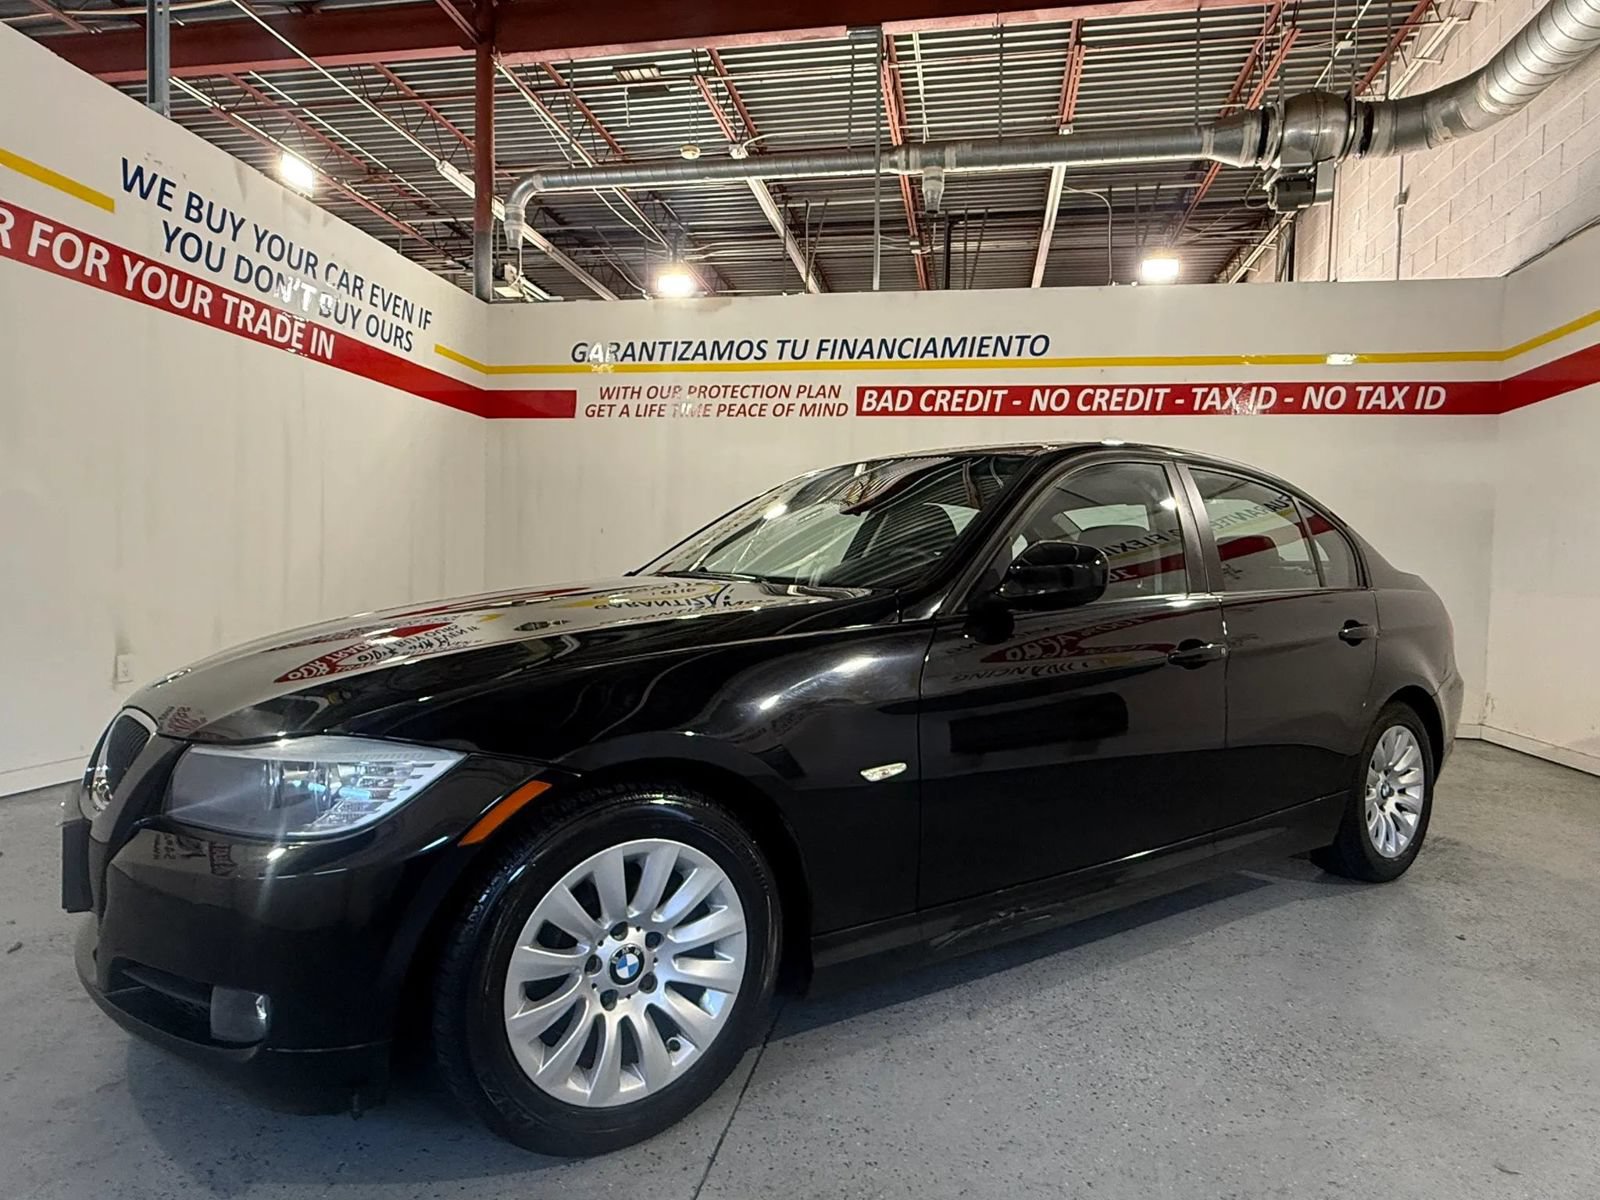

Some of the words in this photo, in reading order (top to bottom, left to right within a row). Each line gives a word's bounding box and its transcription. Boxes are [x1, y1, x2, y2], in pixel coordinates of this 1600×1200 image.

[121, 157, 177, 213] WE
[184, 191, 247, 242] BUY
[254, 223, 319, 280] YOUR
[324, 262, 364, 302] CAR
[369, 283, 415, 325] EVEN
[418, 307, 433, 331] IF
[27, 220, 110, 283] FOR
[122, 254, 214, 320] YOUR
[222, 293, 307, 349] TRADE
[310, 328, 336, 360] IN
[162, 220, 227, 275] YOU
[234, 254, 318, 312] DON'T
[319, 291, 362, 330] BUY
[366, 314, 414, 352] OURS
[571, 339, 769, 363] GARANTIZAMOS
[775, 338, 810, 361] TU
[816, 334, 1050, 360] FINANCIAMIENTO
[599, 385, 642, 400] WITH
[646, 385, 683, 400] OUR
[688, 384, 791, 400] PROTECTION
[795, 384, 841, 400] PLAN
[861, 388, 914, 413] BAD
[918, 388, 1010, 413] CREDIT
[1028, 388, 1072, 412] NO
[1076, 388, 1172, 412] CREDIT
[1191, 387, 1244, 412] TAX
[1247, 387, 1278, 412] ID
[1301, 387, 1347, 411] NO
[1354, 386, 1411, 411] TAX
[1414, 386, 1447, 411] ID
[585, 403, 616, 418] GET
[618, 403, 630, 418] A
[635, 403, 666, 418] LIFE
[716, 402, 768, 418] PEACE
[772, 402, 796, 418] OF
[799, 401, 849, 418] MIND
